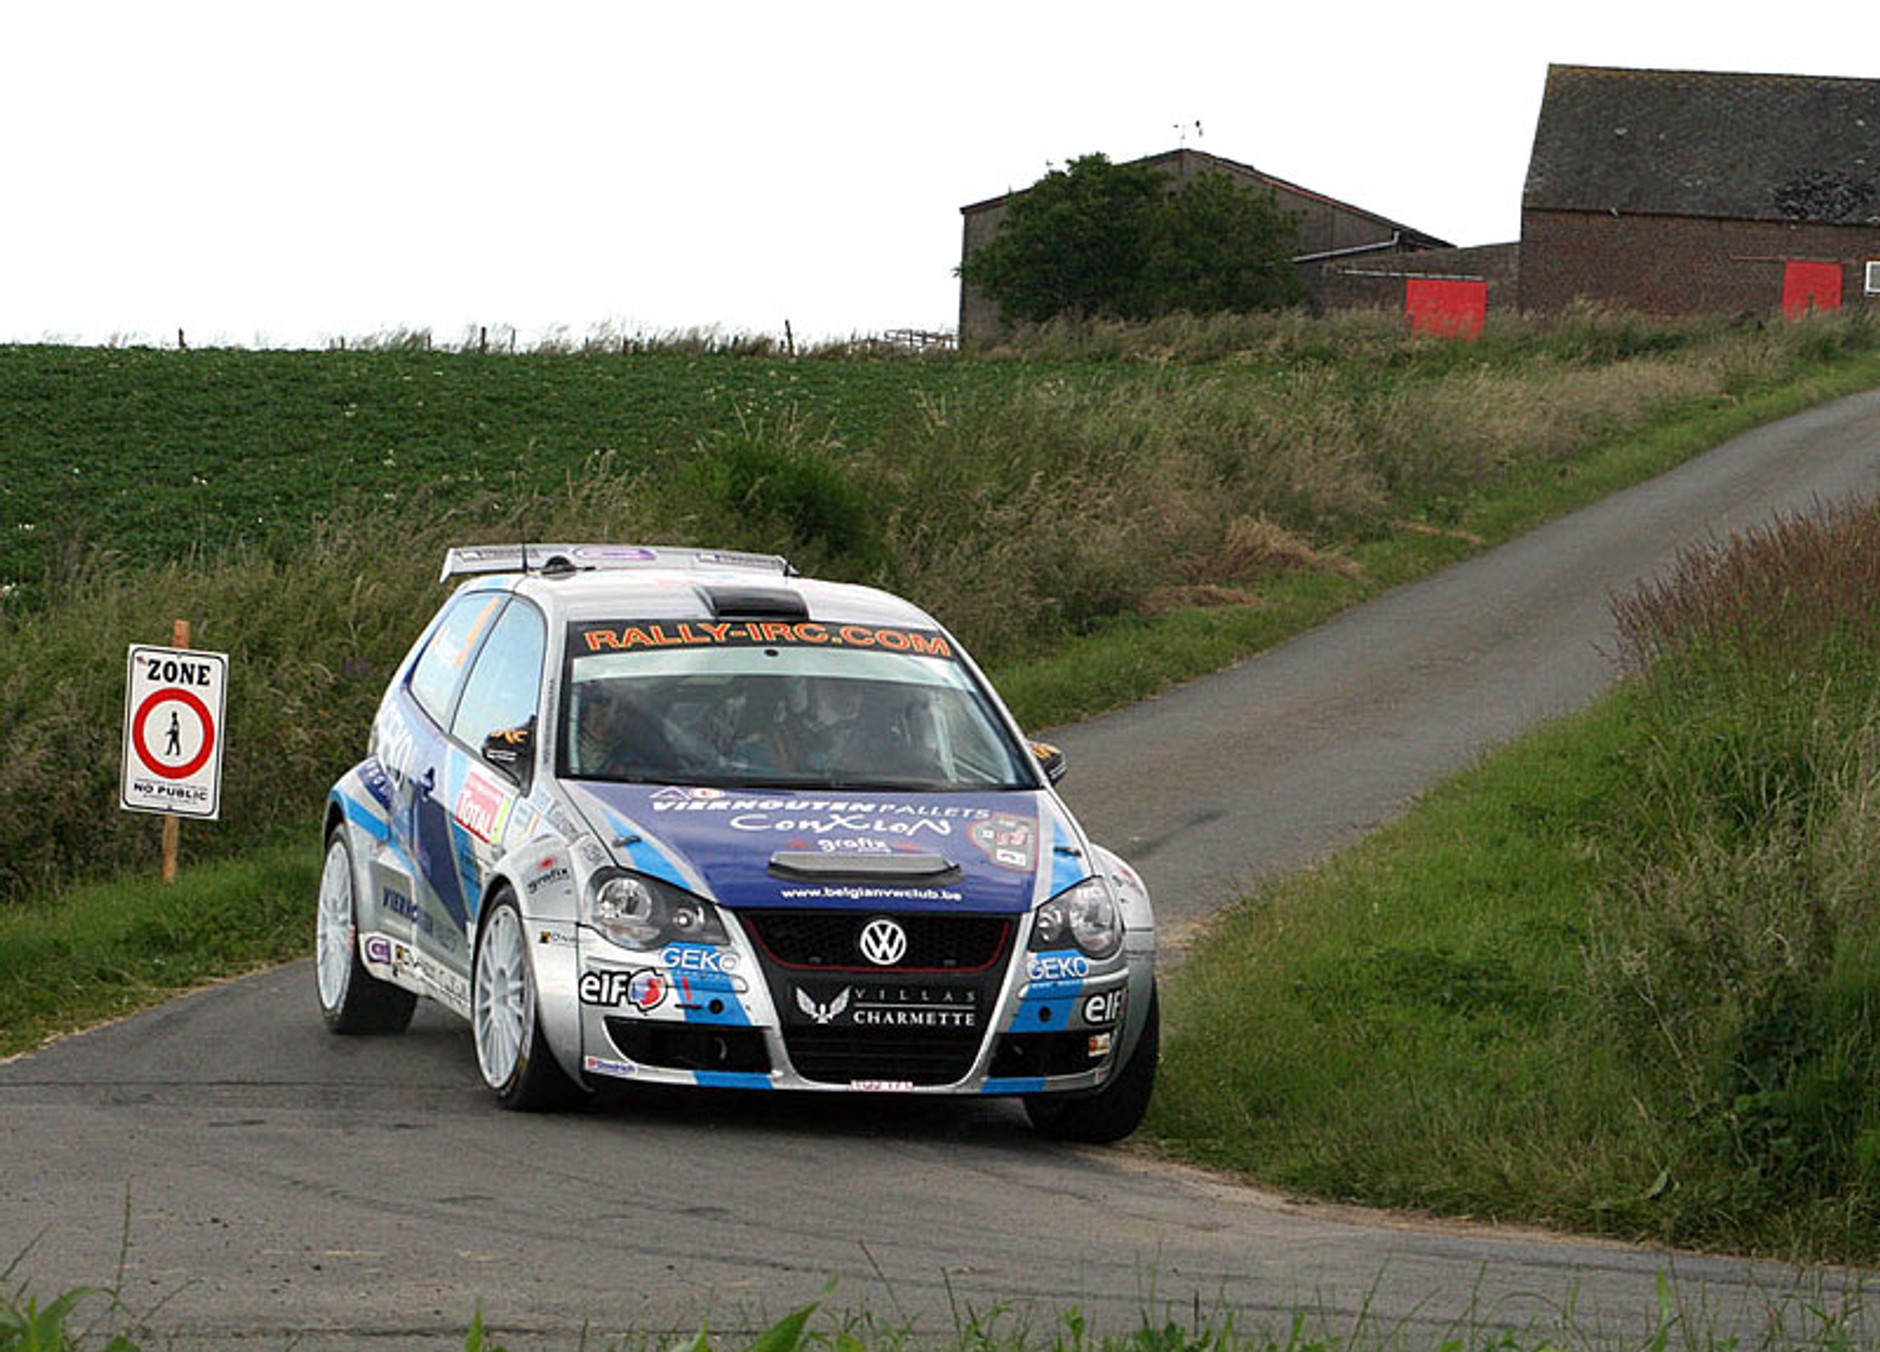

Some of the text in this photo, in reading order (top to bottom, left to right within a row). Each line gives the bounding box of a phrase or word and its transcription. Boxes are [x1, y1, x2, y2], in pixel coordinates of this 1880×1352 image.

[583, 623, 952, 657] RALLY-IRC.COM
[147, 659, 211, 686] ZONE
[134, 783, 154, 793] NO
[157, 785, 208, 801] PUBLIC
[879, 804, 990, 819] PALLETS
[659, 947, 741, 971] GEKO
[1027, 956, 1090, 980] GEKO
[579, 973, 630, 1004] elf
[854, 990, 977, 1001] VILLAS
[853, 1010, 976, 1026] CHARMETTE
[1085, 993, 1123, 1022] elf
